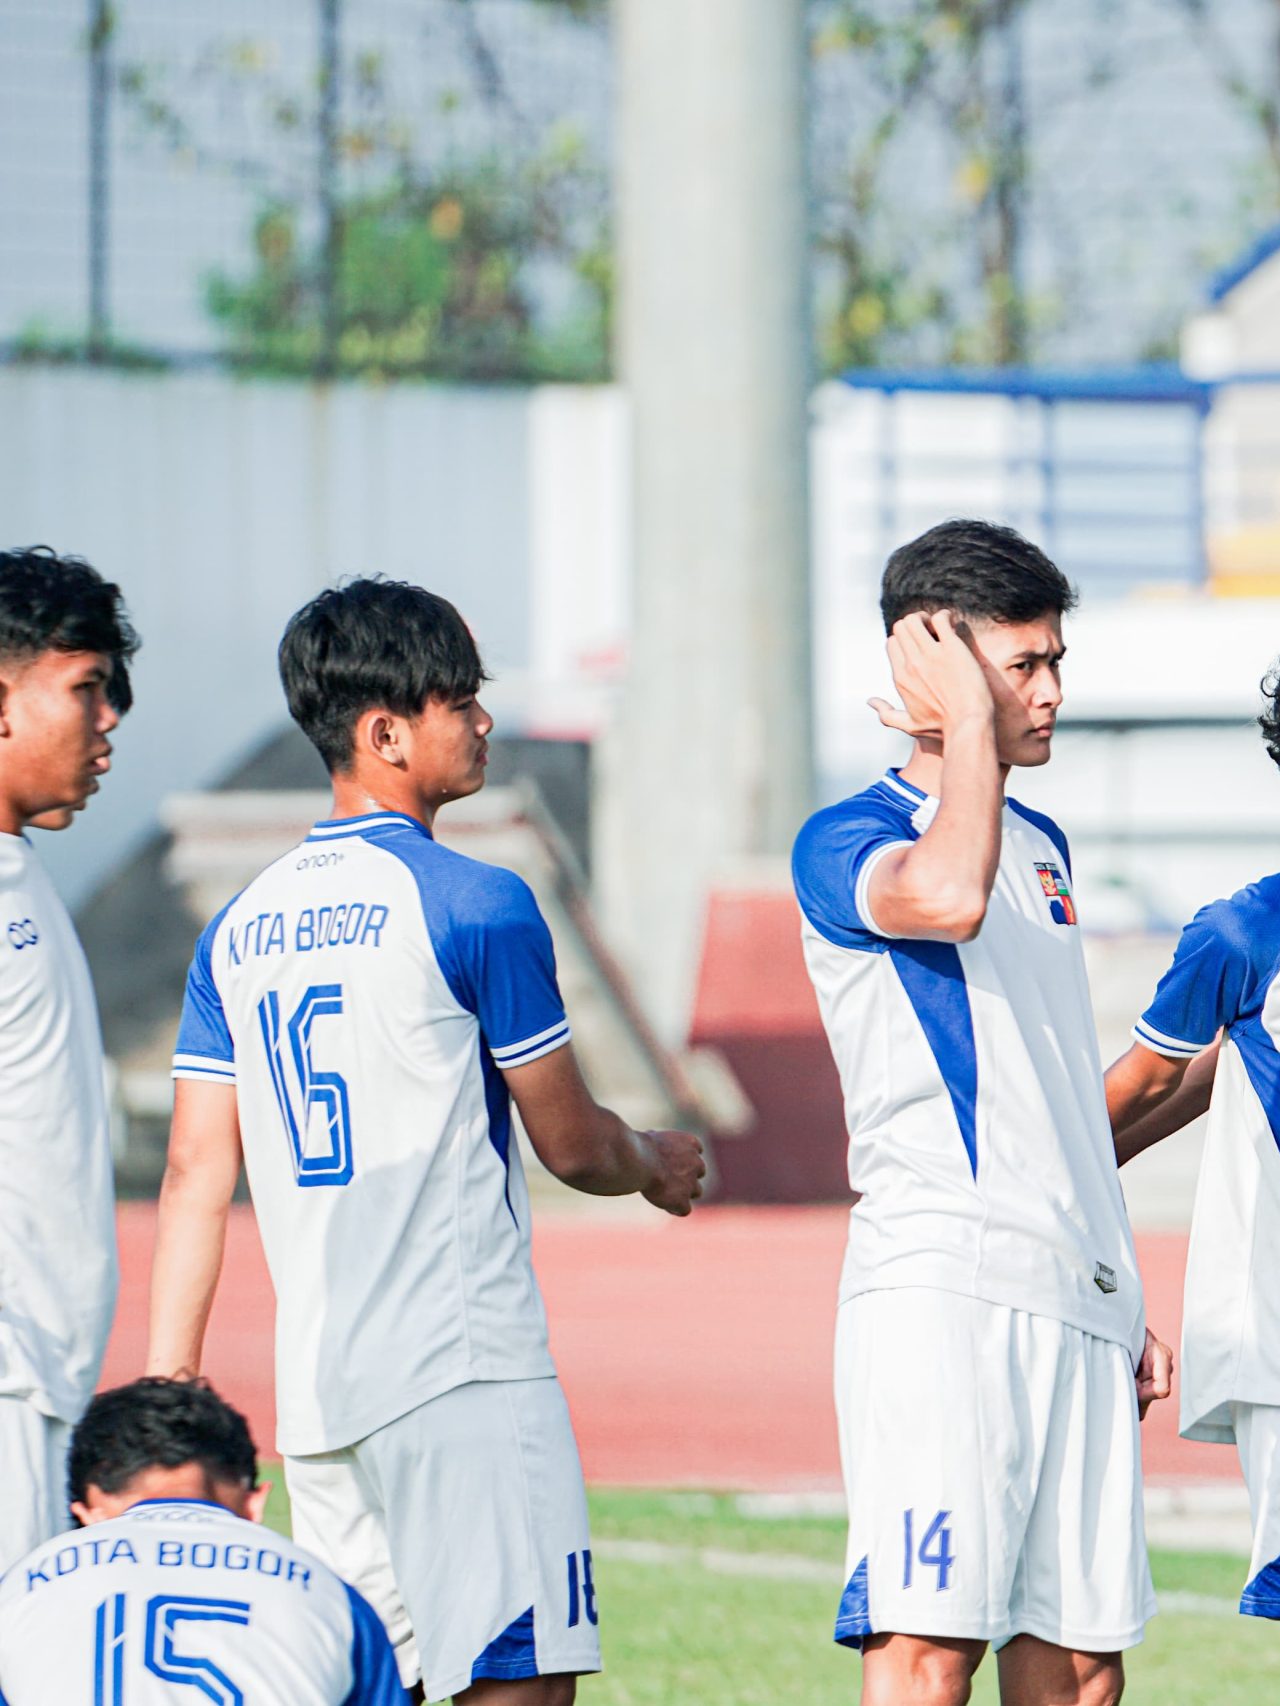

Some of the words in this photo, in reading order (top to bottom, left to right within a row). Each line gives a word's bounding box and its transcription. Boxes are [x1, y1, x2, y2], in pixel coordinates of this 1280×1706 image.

[295, 903, 389, 952] BOGOR
[257, 983, 354, 1187] 16
[27, 1539, 138, 1592] KOTA
[158, 1541, 311, 1591] BOGOR
[903, 1508, 956, 1591] 14
[94, 1593, 250, 1706] 15
